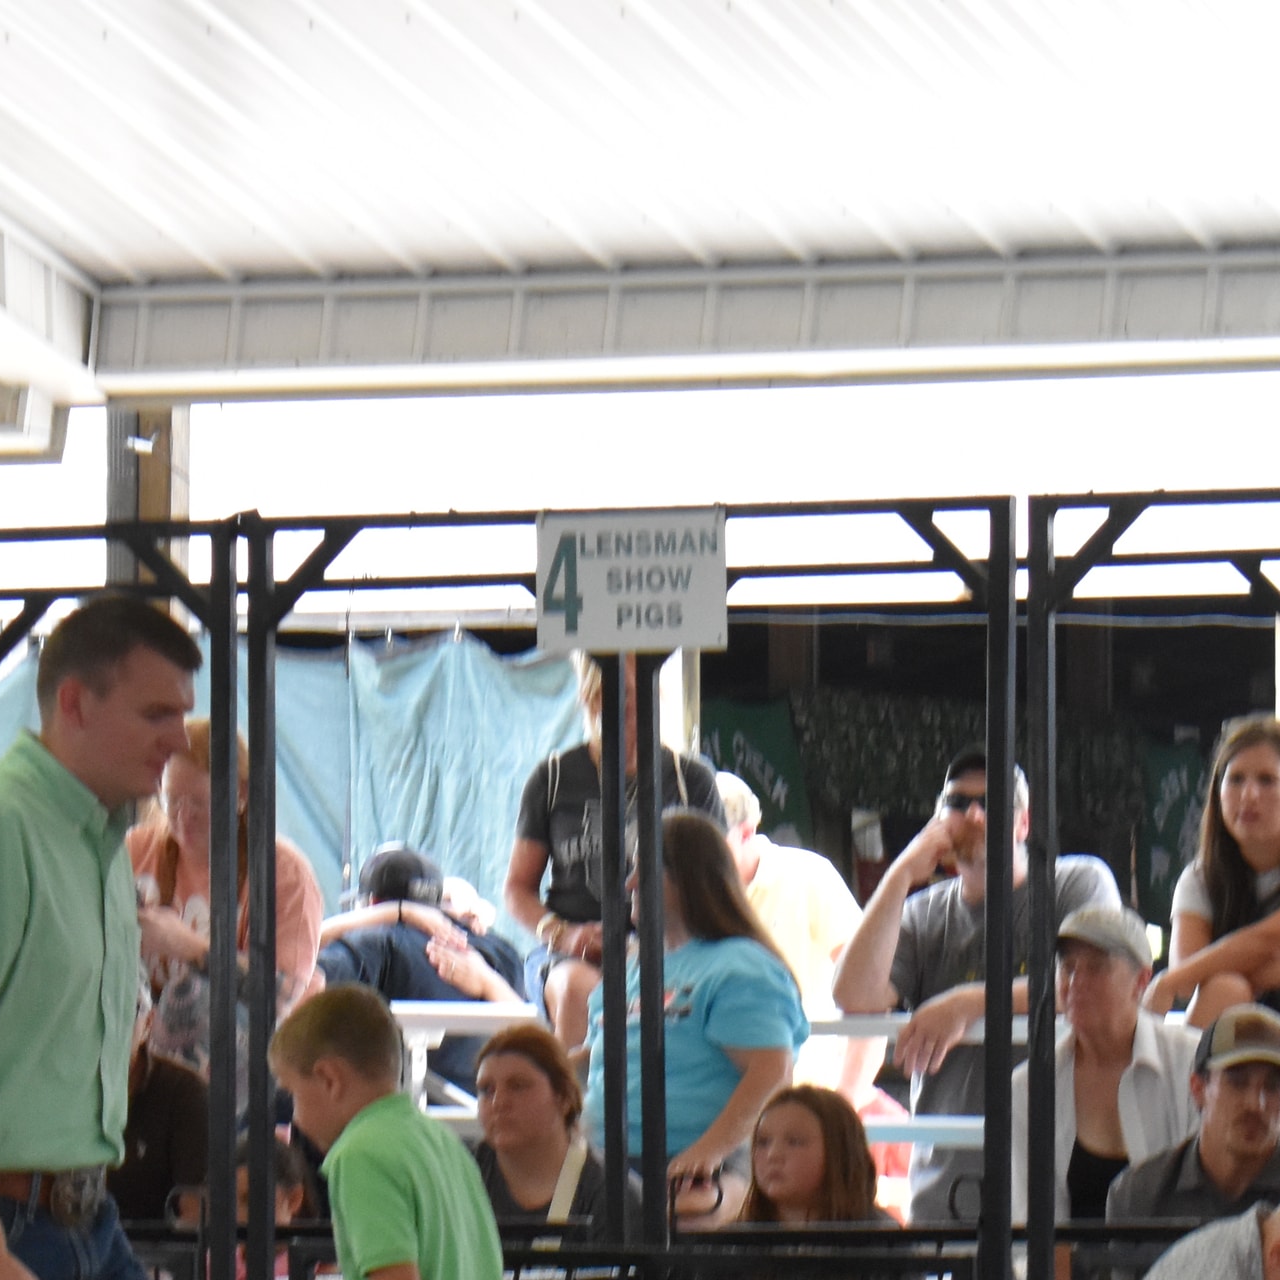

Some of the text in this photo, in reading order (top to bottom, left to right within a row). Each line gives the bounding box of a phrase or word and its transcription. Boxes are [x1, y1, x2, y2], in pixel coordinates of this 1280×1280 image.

[579, 527, 718, 560] LENSMAN
[543, 530, 583, 637] 4
[606, 564, 693, 595] SHOW
[616, 601, 684, 630] PIGS
